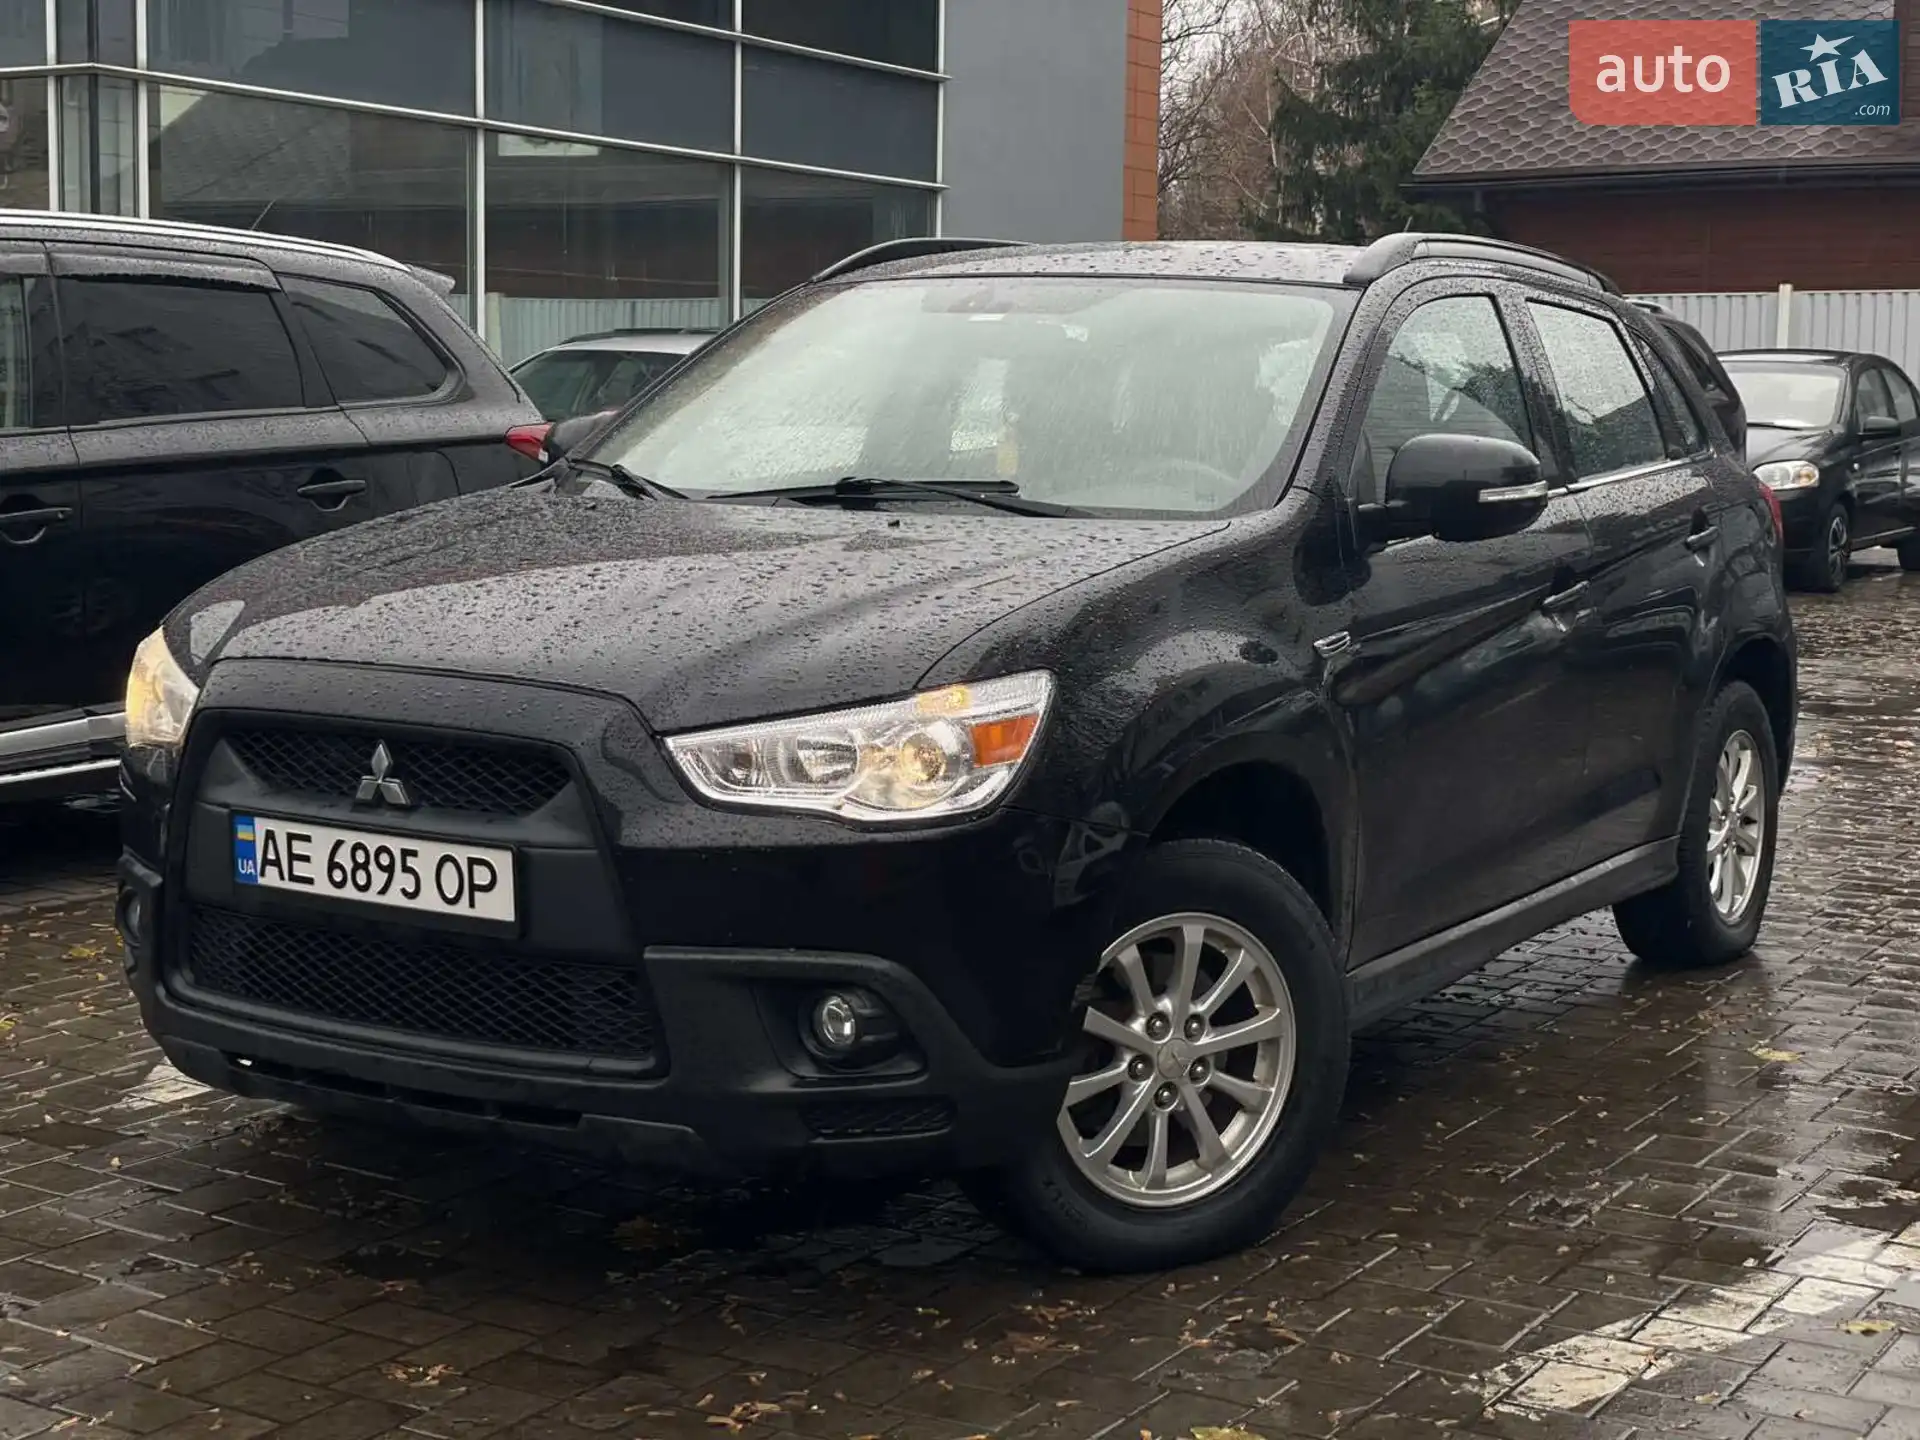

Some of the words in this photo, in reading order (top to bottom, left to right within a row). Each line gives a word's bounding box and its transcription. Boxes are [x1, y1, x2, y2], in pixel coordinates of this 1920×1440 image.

[238, 858, 256, 875] UA
[259, 828, 315, 885] AE
[327, 839, 422, 900] 6895
[435, 853, 497, 909] OP
